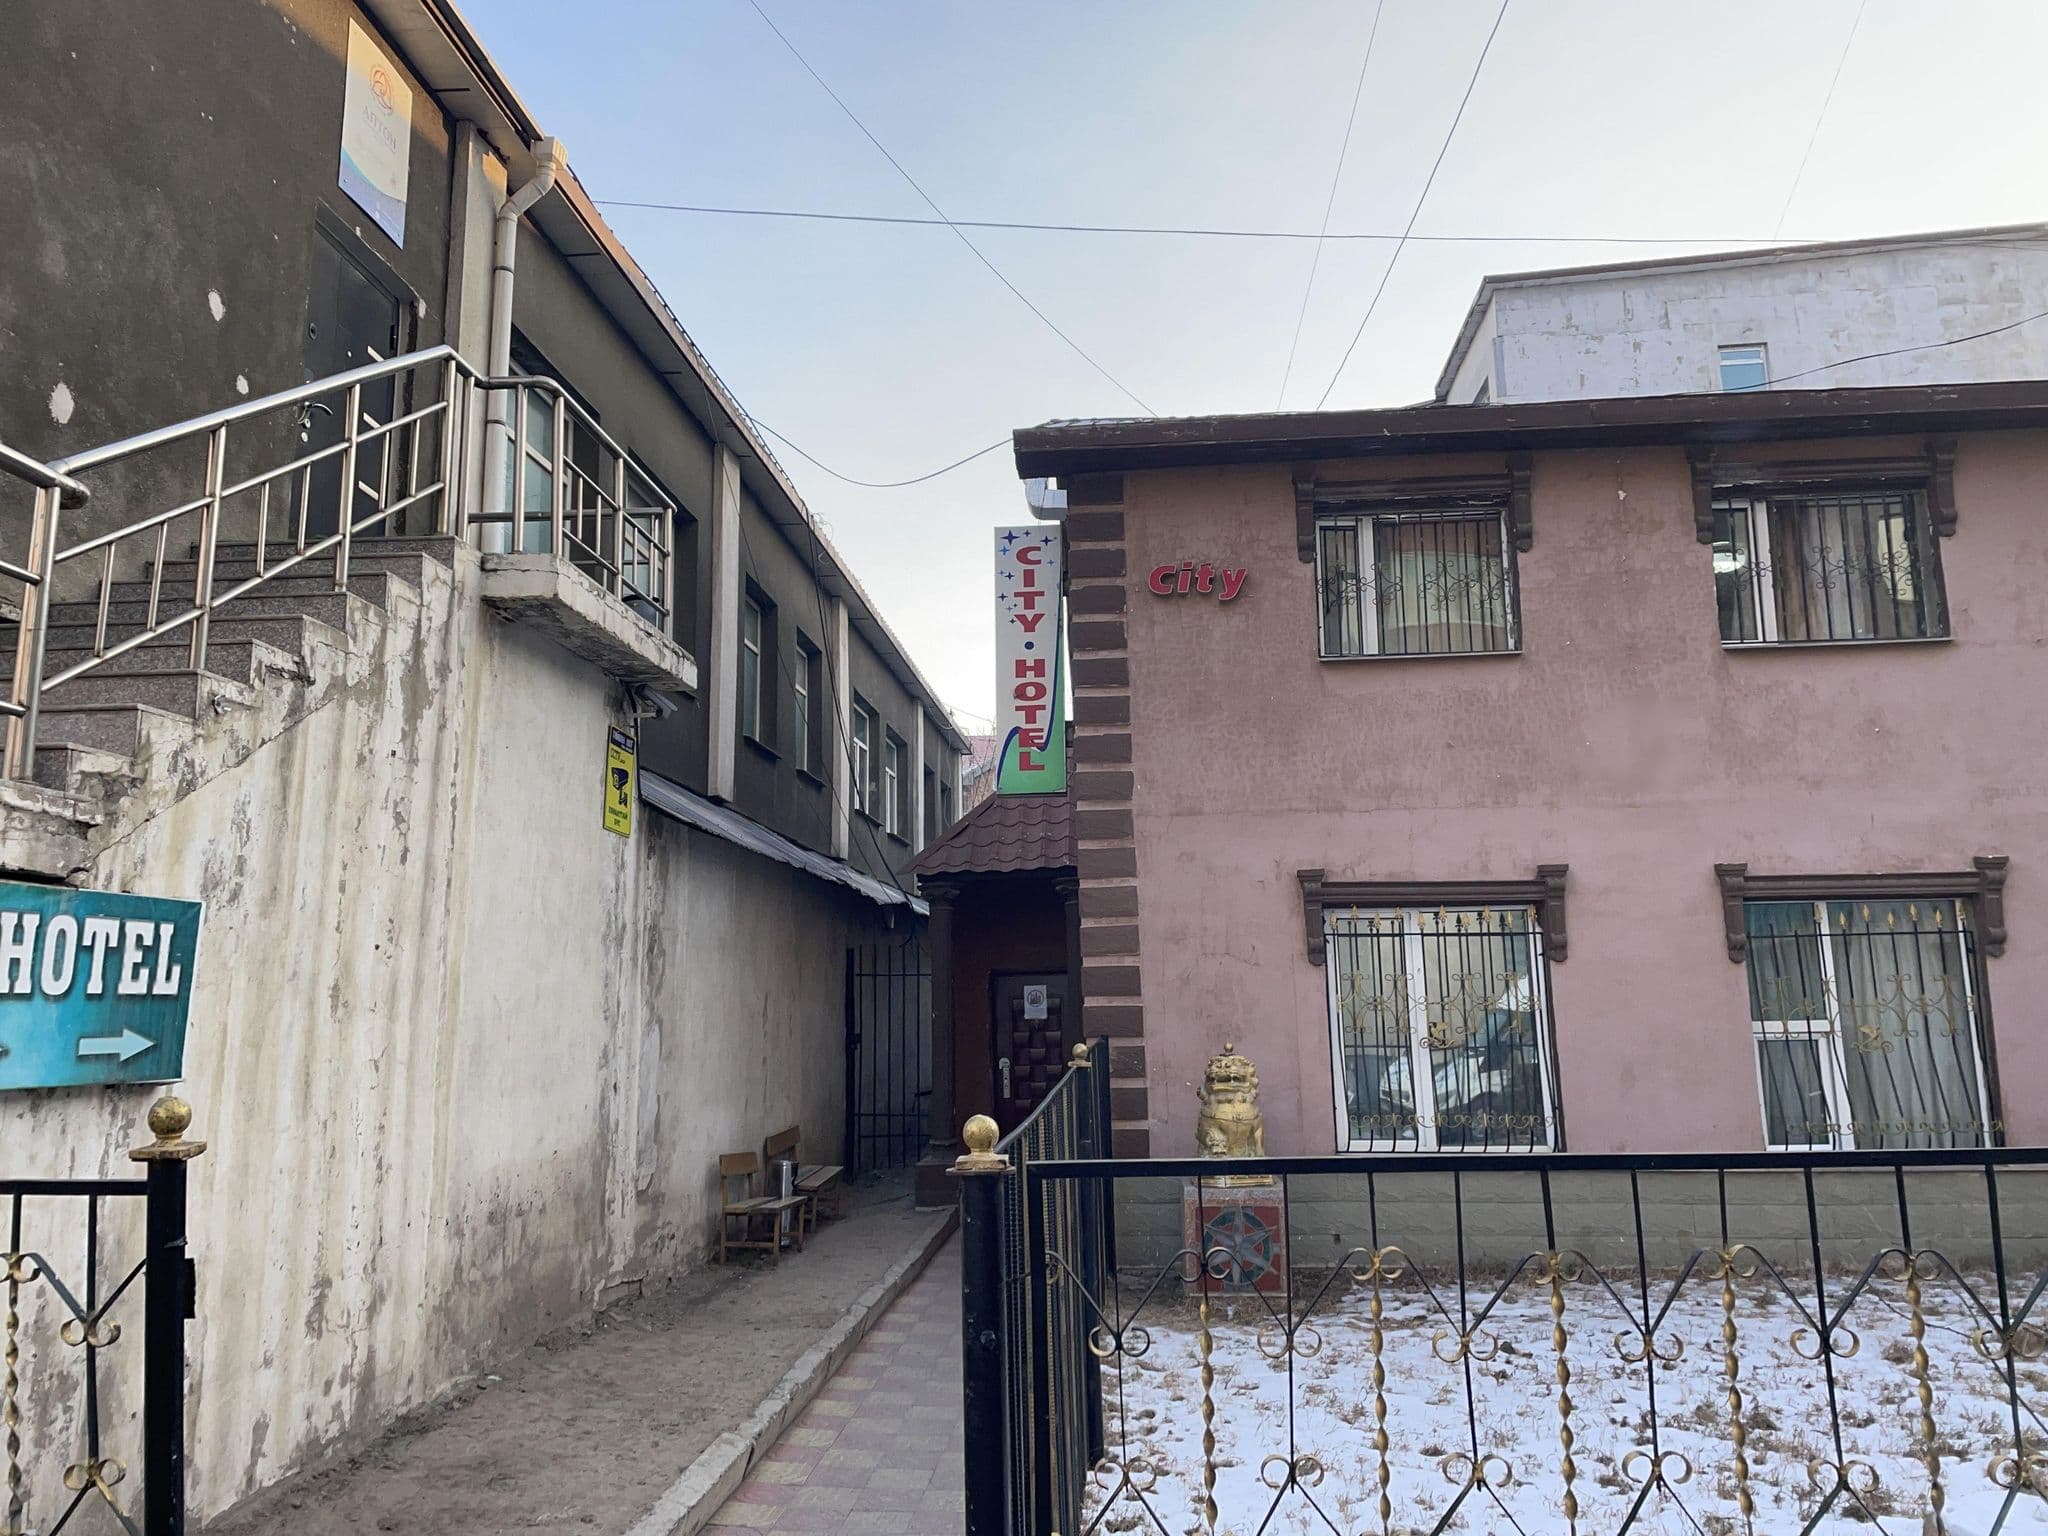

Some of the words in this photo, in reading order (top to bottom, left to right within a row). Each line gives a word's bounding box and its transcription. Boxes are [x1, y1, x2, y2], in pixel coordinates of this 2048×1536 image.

[1014, 546, 1045, 632] CITY
[1015, 659, 1047, 771] HOTEL
[0, 911, 181, 995] HOTEL
